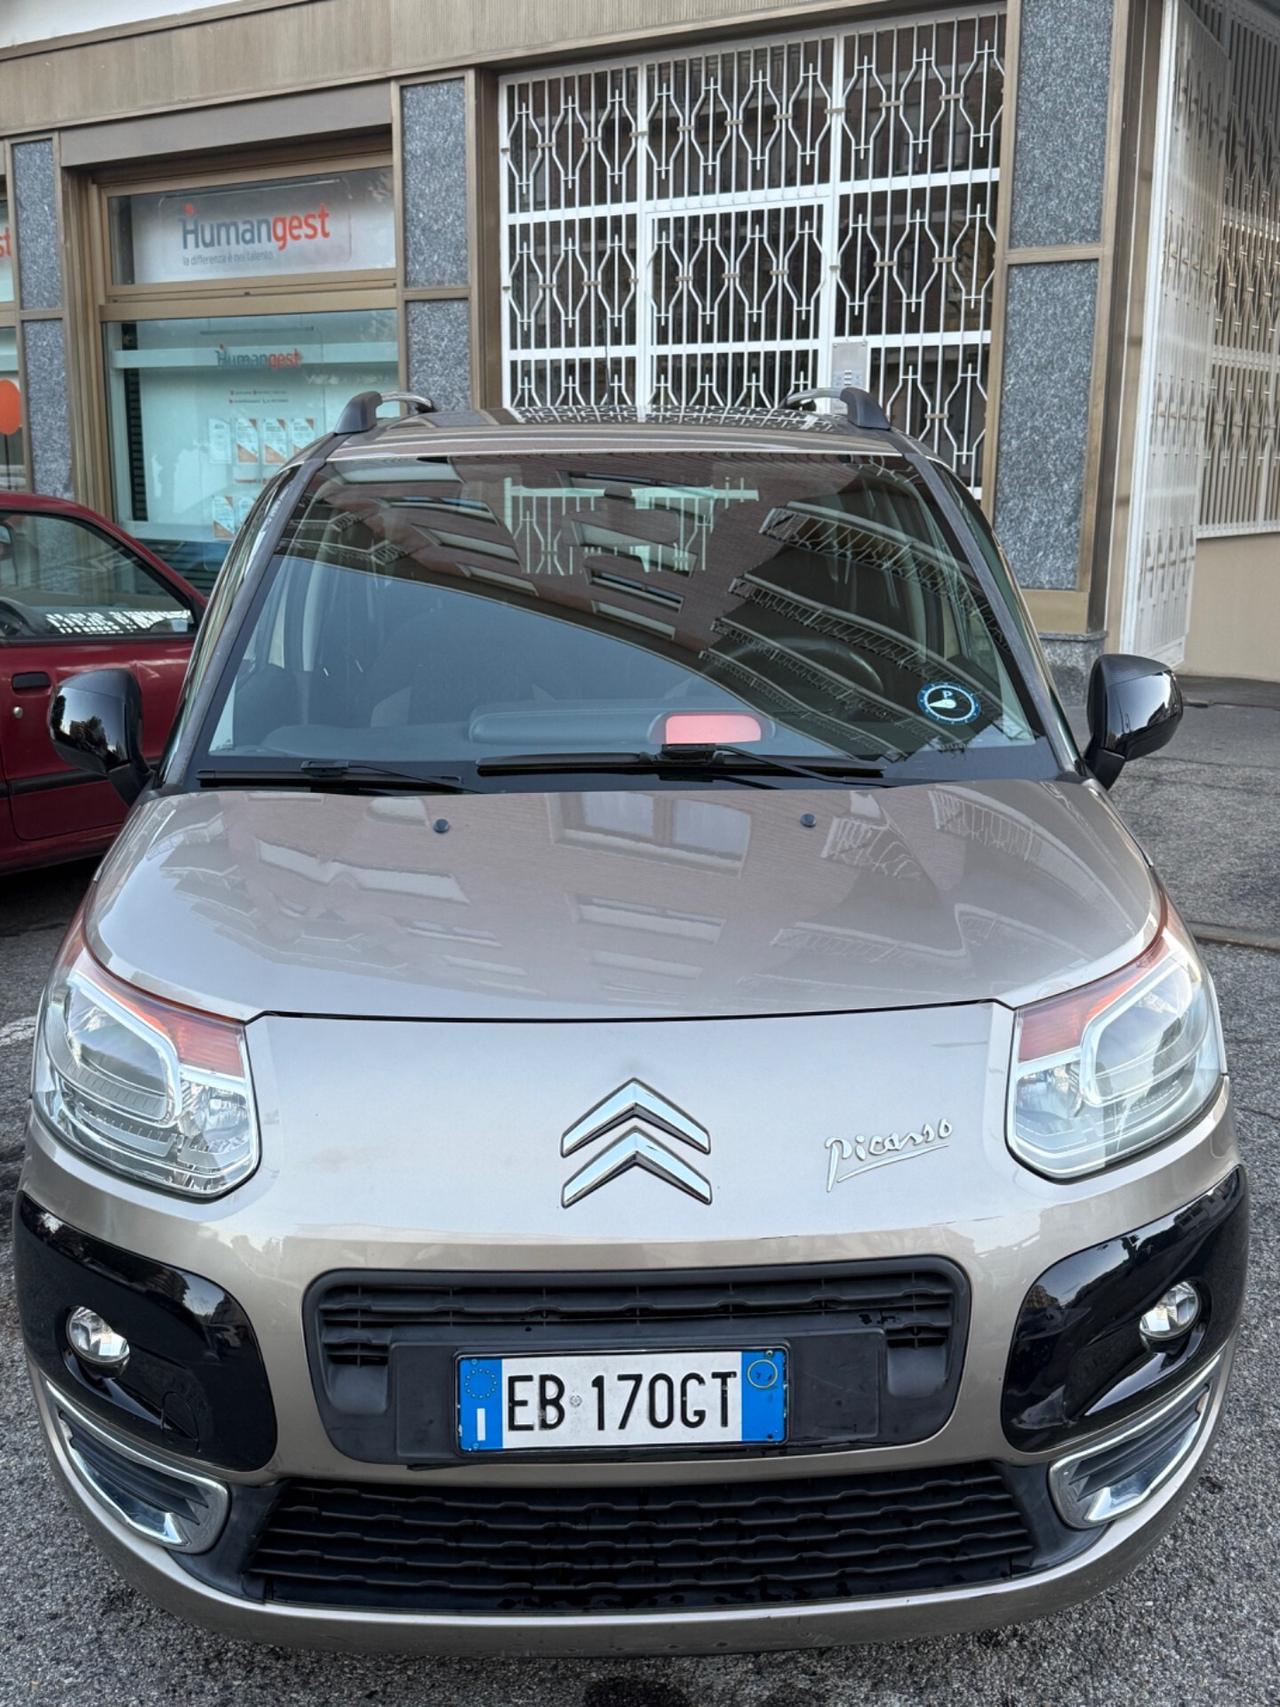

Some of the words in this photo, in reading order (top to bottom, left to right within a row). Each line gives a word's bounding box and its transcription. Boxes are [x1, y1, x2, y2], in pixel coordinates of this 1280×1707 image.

[178, 203, 330, 250] Humangest
[214, 344, 302, 371] Humangest
[942, 690, 953, 699] P
[825, 1118, 953, 1192] Picasso
